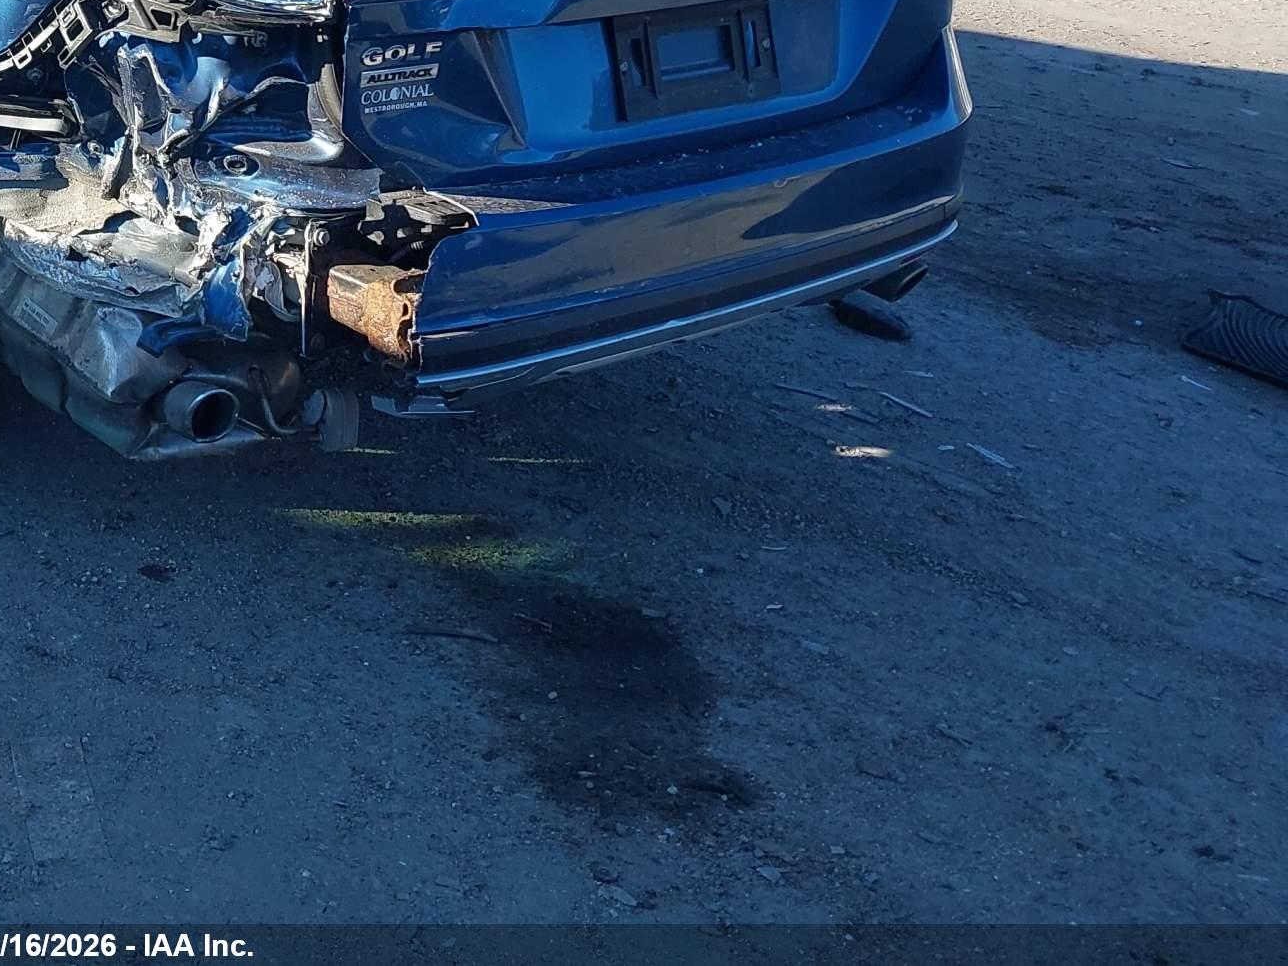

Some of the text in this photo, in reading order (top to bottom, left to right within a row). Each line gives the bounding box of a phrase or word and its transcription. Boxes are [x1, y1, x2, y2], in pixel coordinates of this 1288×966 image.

[361, 41, 443, 66] GOLF
[366, 67, 433, 84] ALLTRACK
[361, 84, 434, 105] COLONIAL
